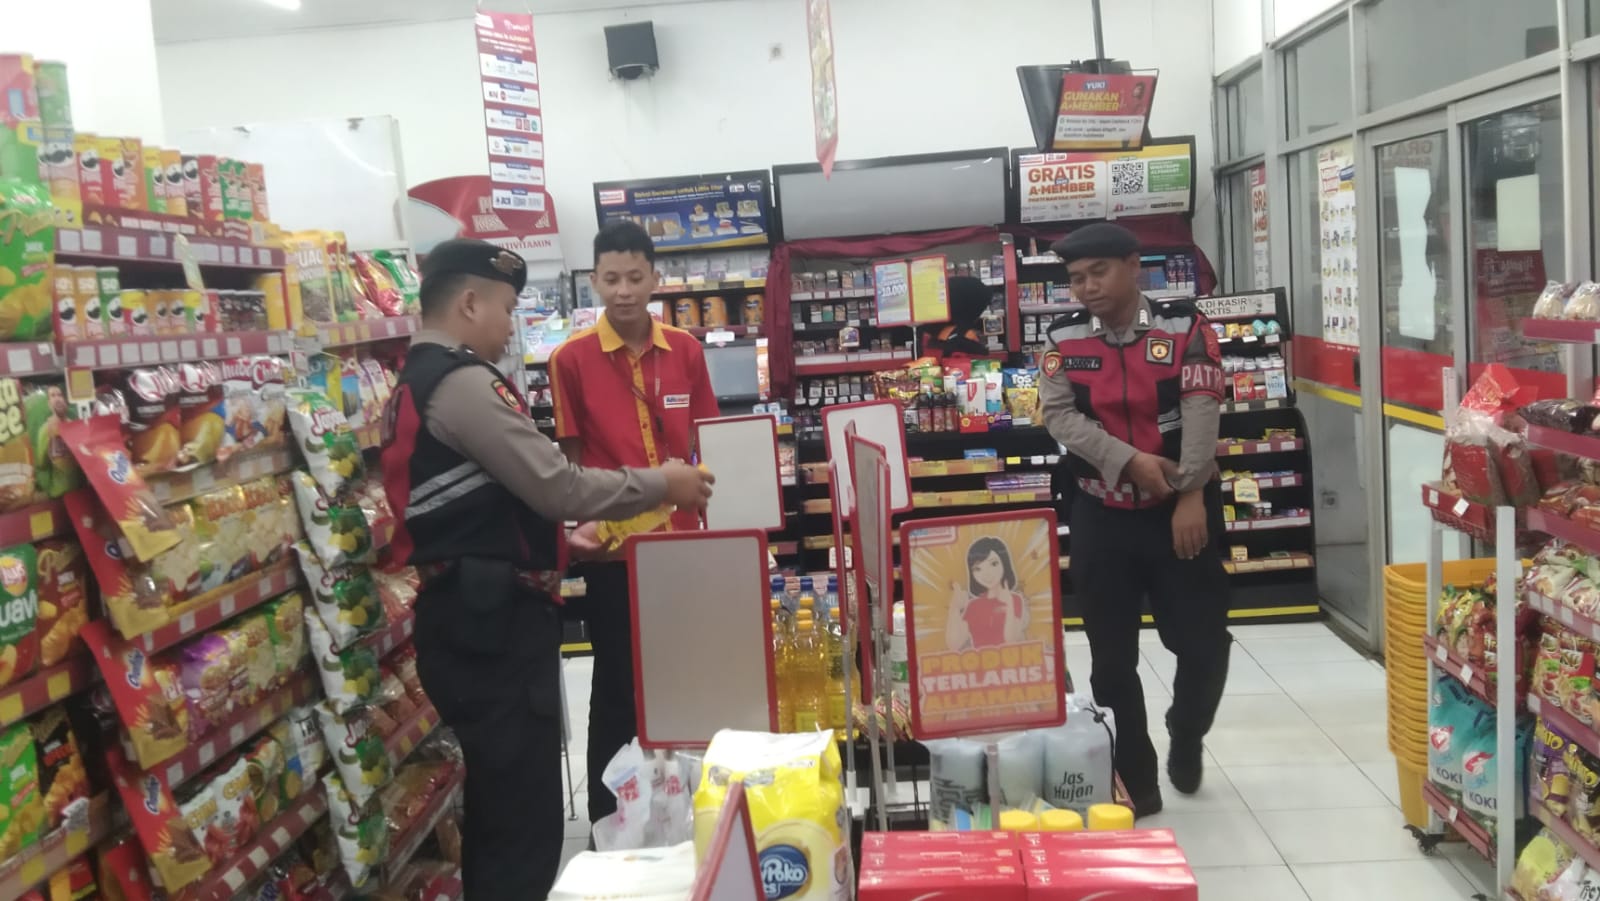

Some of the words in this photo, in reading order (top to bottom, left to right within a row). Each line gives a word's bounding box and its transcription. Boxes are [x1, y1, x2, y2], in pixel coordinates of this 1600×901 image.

[1064, 92, 1119, 101] GUNAKAN
[1028, 164, 1096, 183] GRATIS
[922, 642, 1043, 674] PRODUK
[1062, 771, 1084, 785] Jas
[1437, 767, 1462, 785] KOKI
[1054, 784, 1093, 802] Hujan
